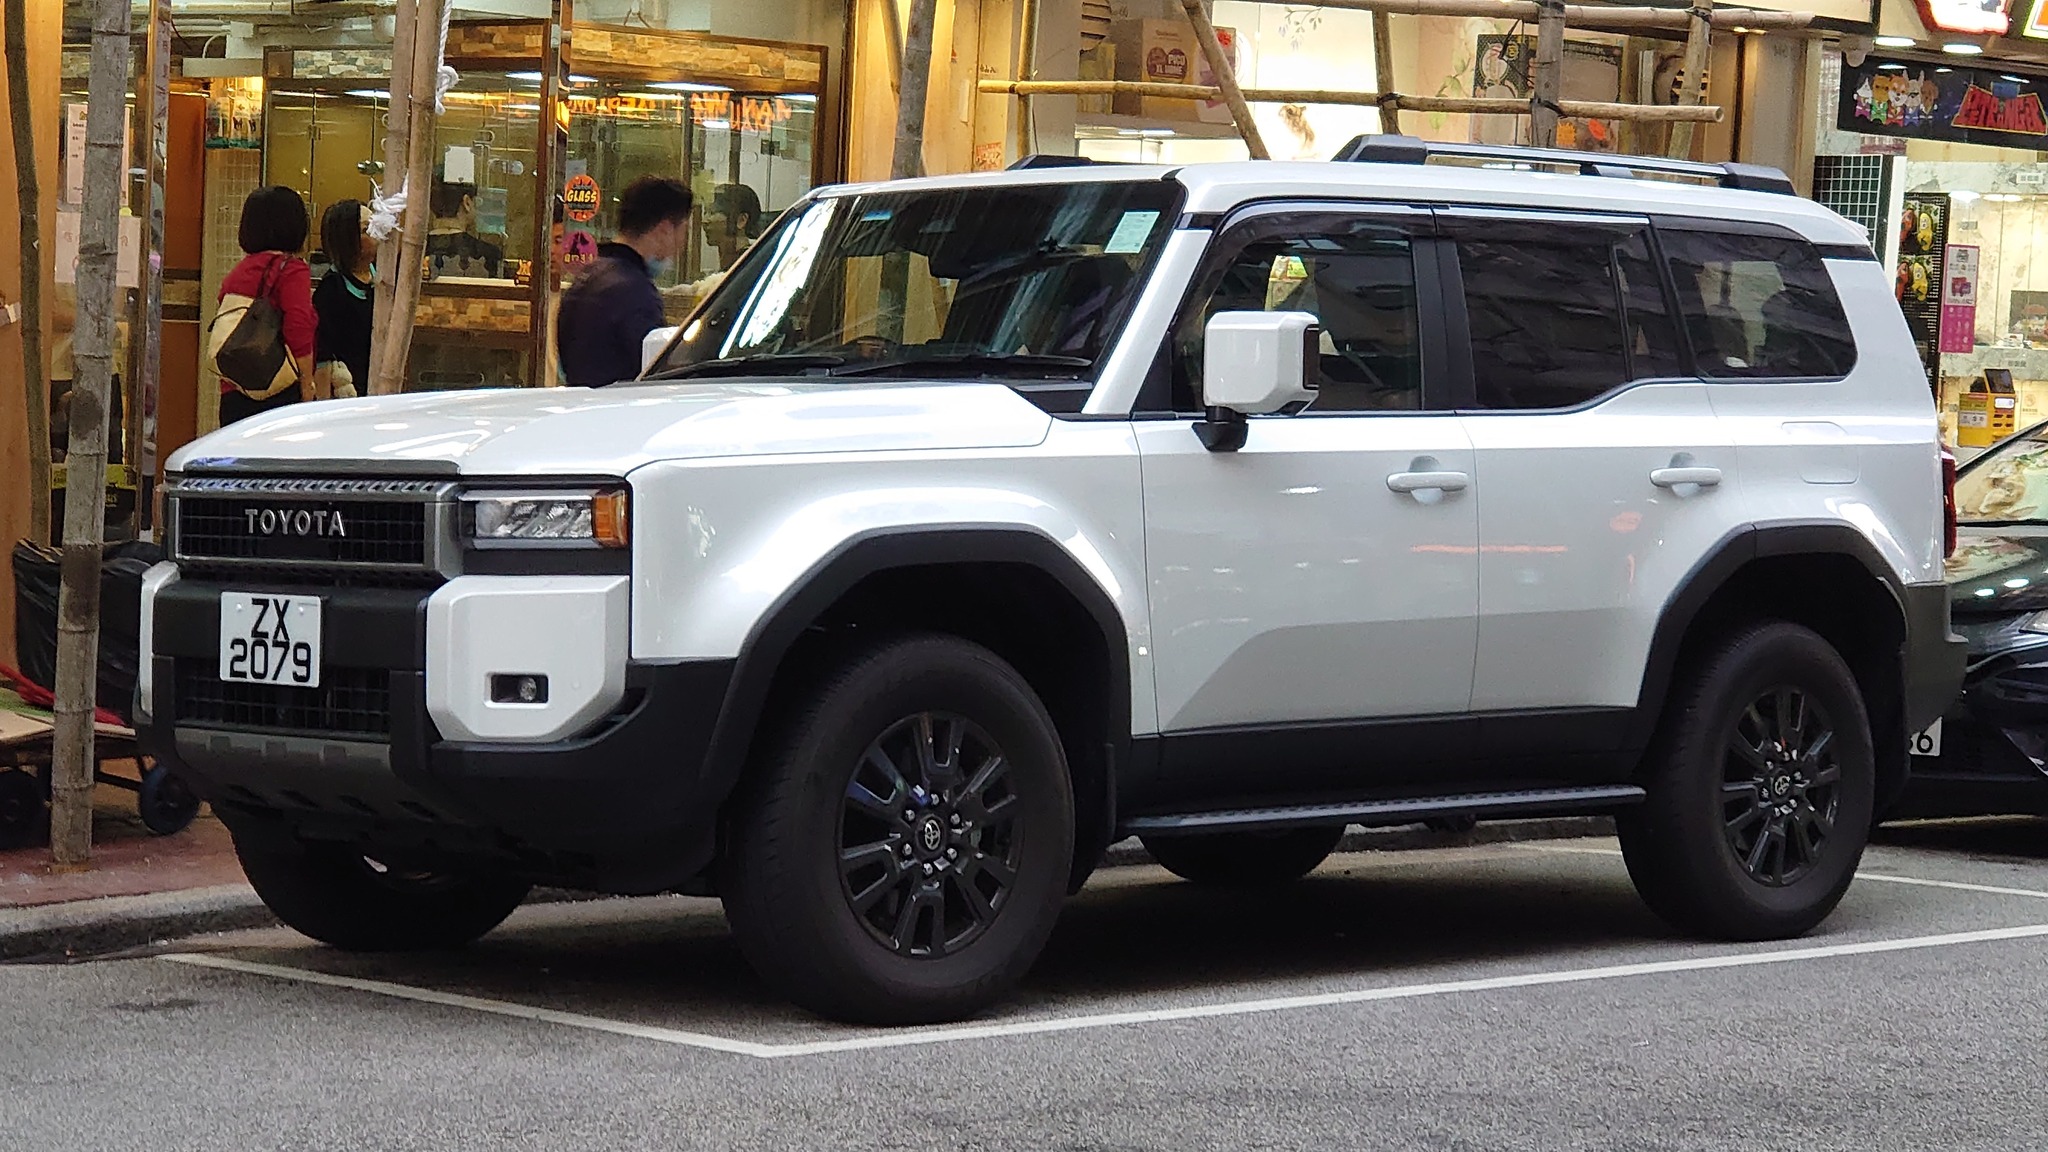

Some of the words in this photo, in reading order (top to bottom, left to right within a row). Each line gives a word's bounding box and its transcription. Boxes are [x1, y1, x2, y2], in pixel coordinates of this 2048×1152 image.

[567, 189, 597, 203] GLASS
[244, 508, 346, 537] TOYOTA
[251, 598, 290, 640] ZX
[229, 638, 311, 683] 2079
